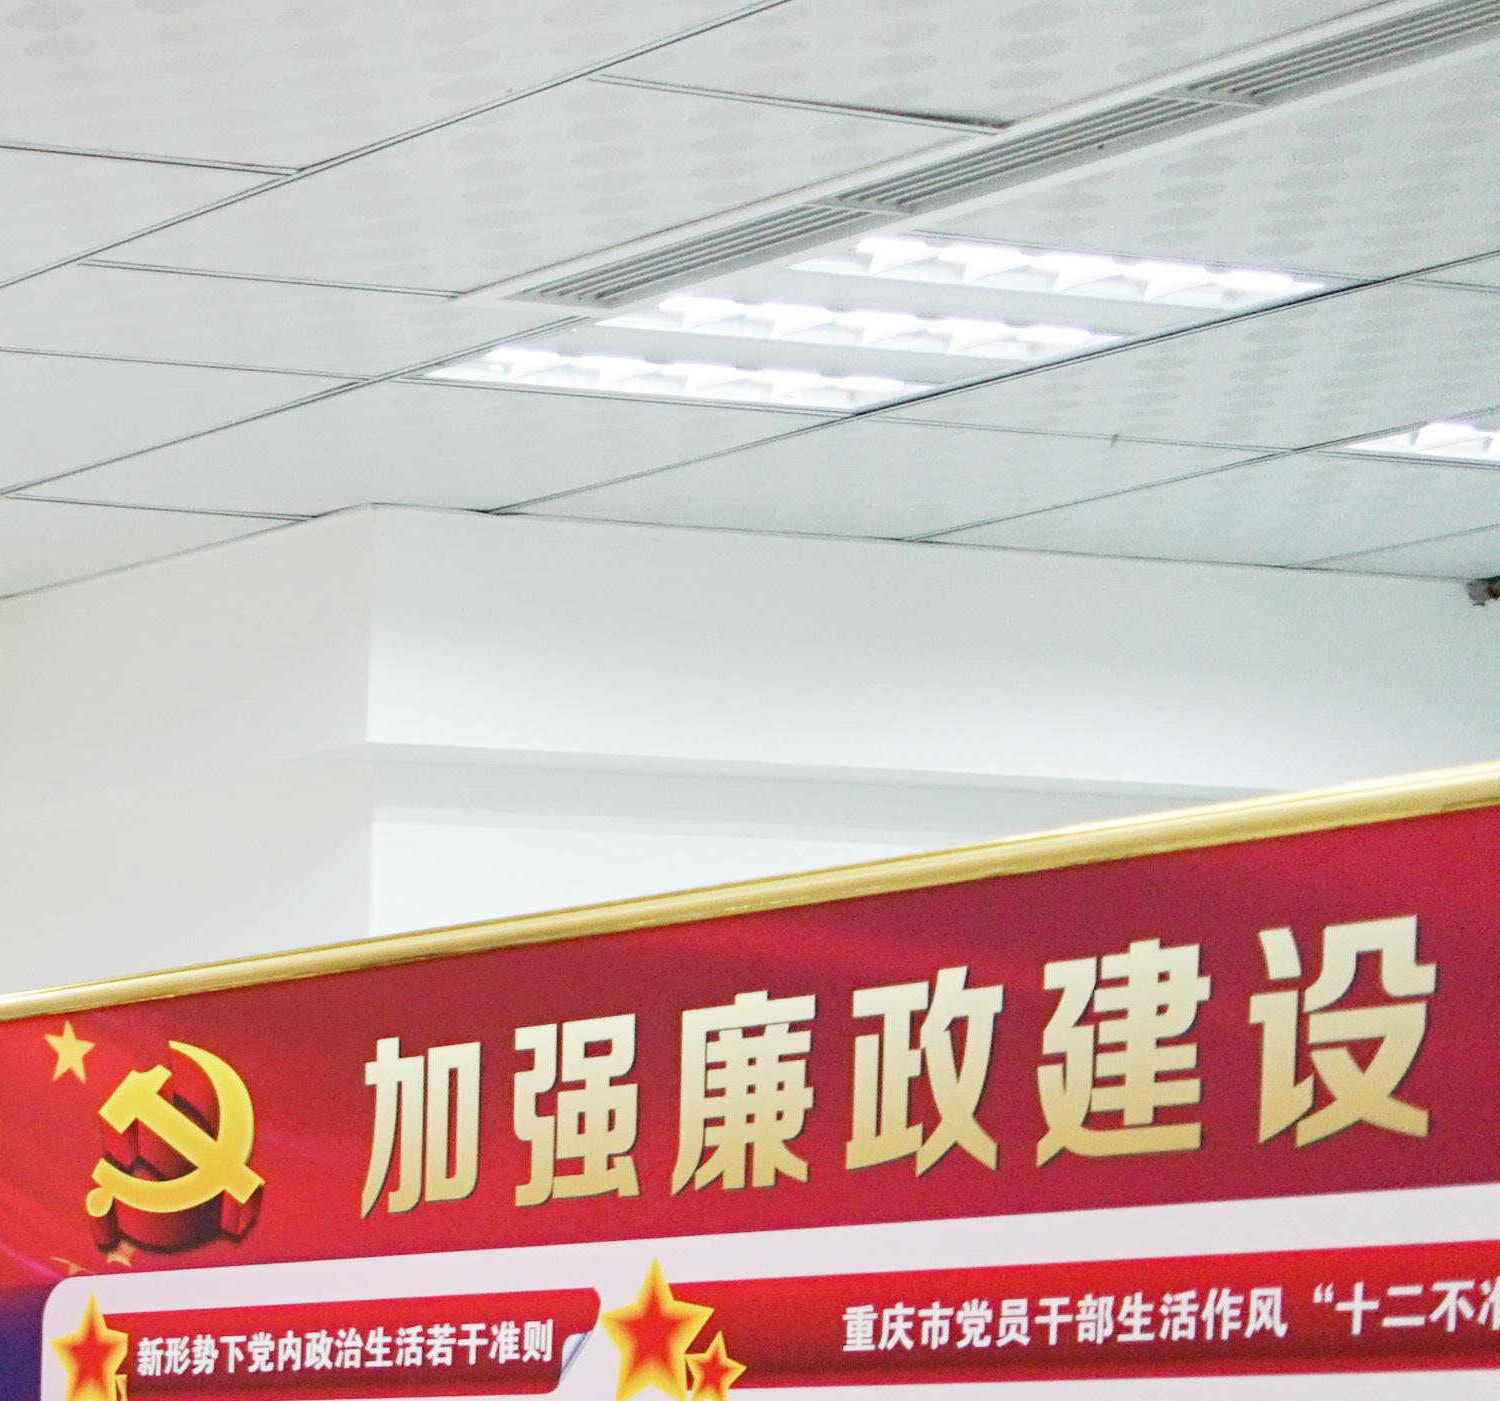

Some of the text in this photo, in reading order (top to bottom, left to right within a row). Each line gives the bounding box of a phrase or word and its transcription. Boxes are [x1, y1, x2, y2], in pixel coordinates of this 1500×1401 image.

[361, 914, 1438, 1219] 加强廉政建设
[136, 1317, 554, 1378] 新形势下党内政治生活若干准则
